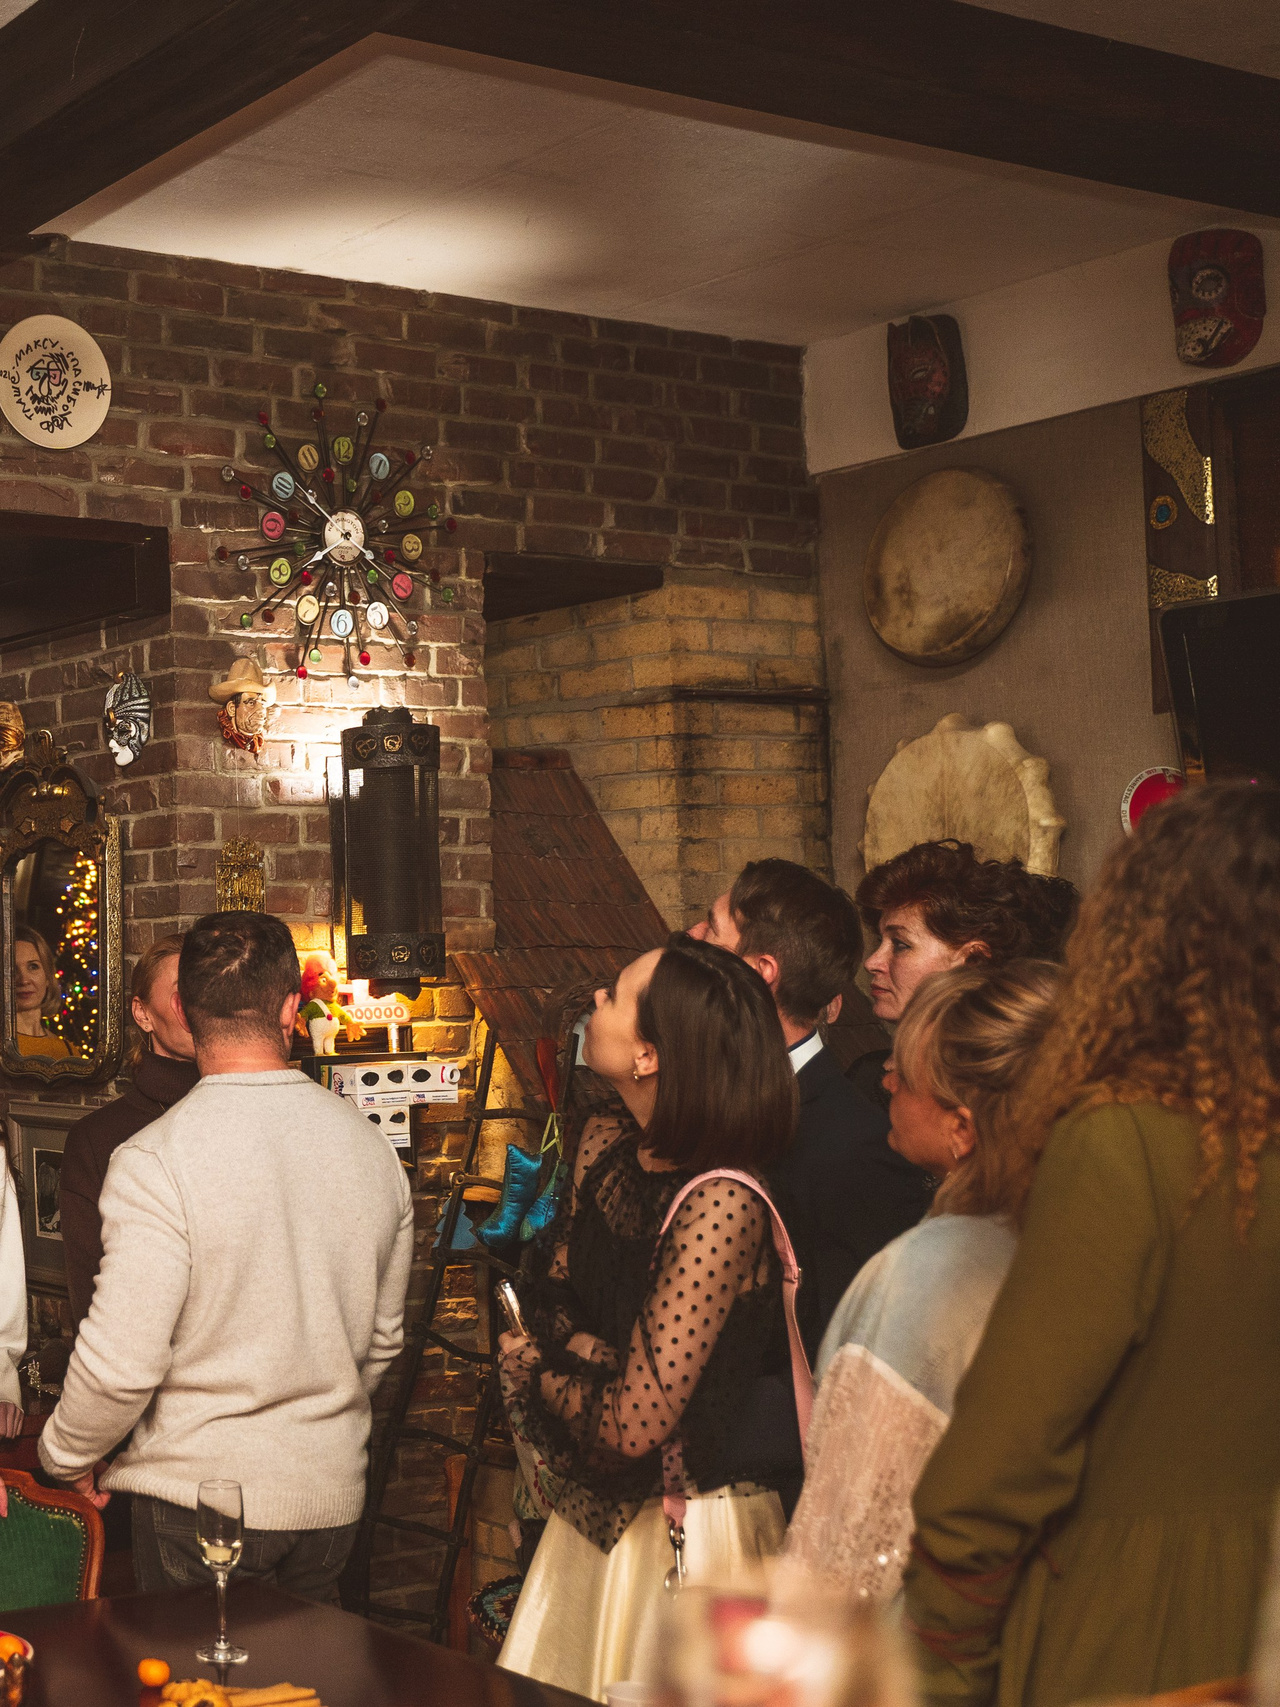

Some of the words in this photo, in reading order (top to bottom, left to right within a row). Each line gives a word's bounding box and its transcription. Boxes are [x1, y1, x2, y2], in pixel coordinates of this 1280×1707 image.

[14, 338, 59, 366] МАКСУ
[337, 440, 351, 462] 12
[275, 476, 292, 496] 10
[397, 495, 411, 511] 2
[301, 598, 316, 618] 7
[370, 605, 384, 626] 5
[337, 613, 348, 633] 6
